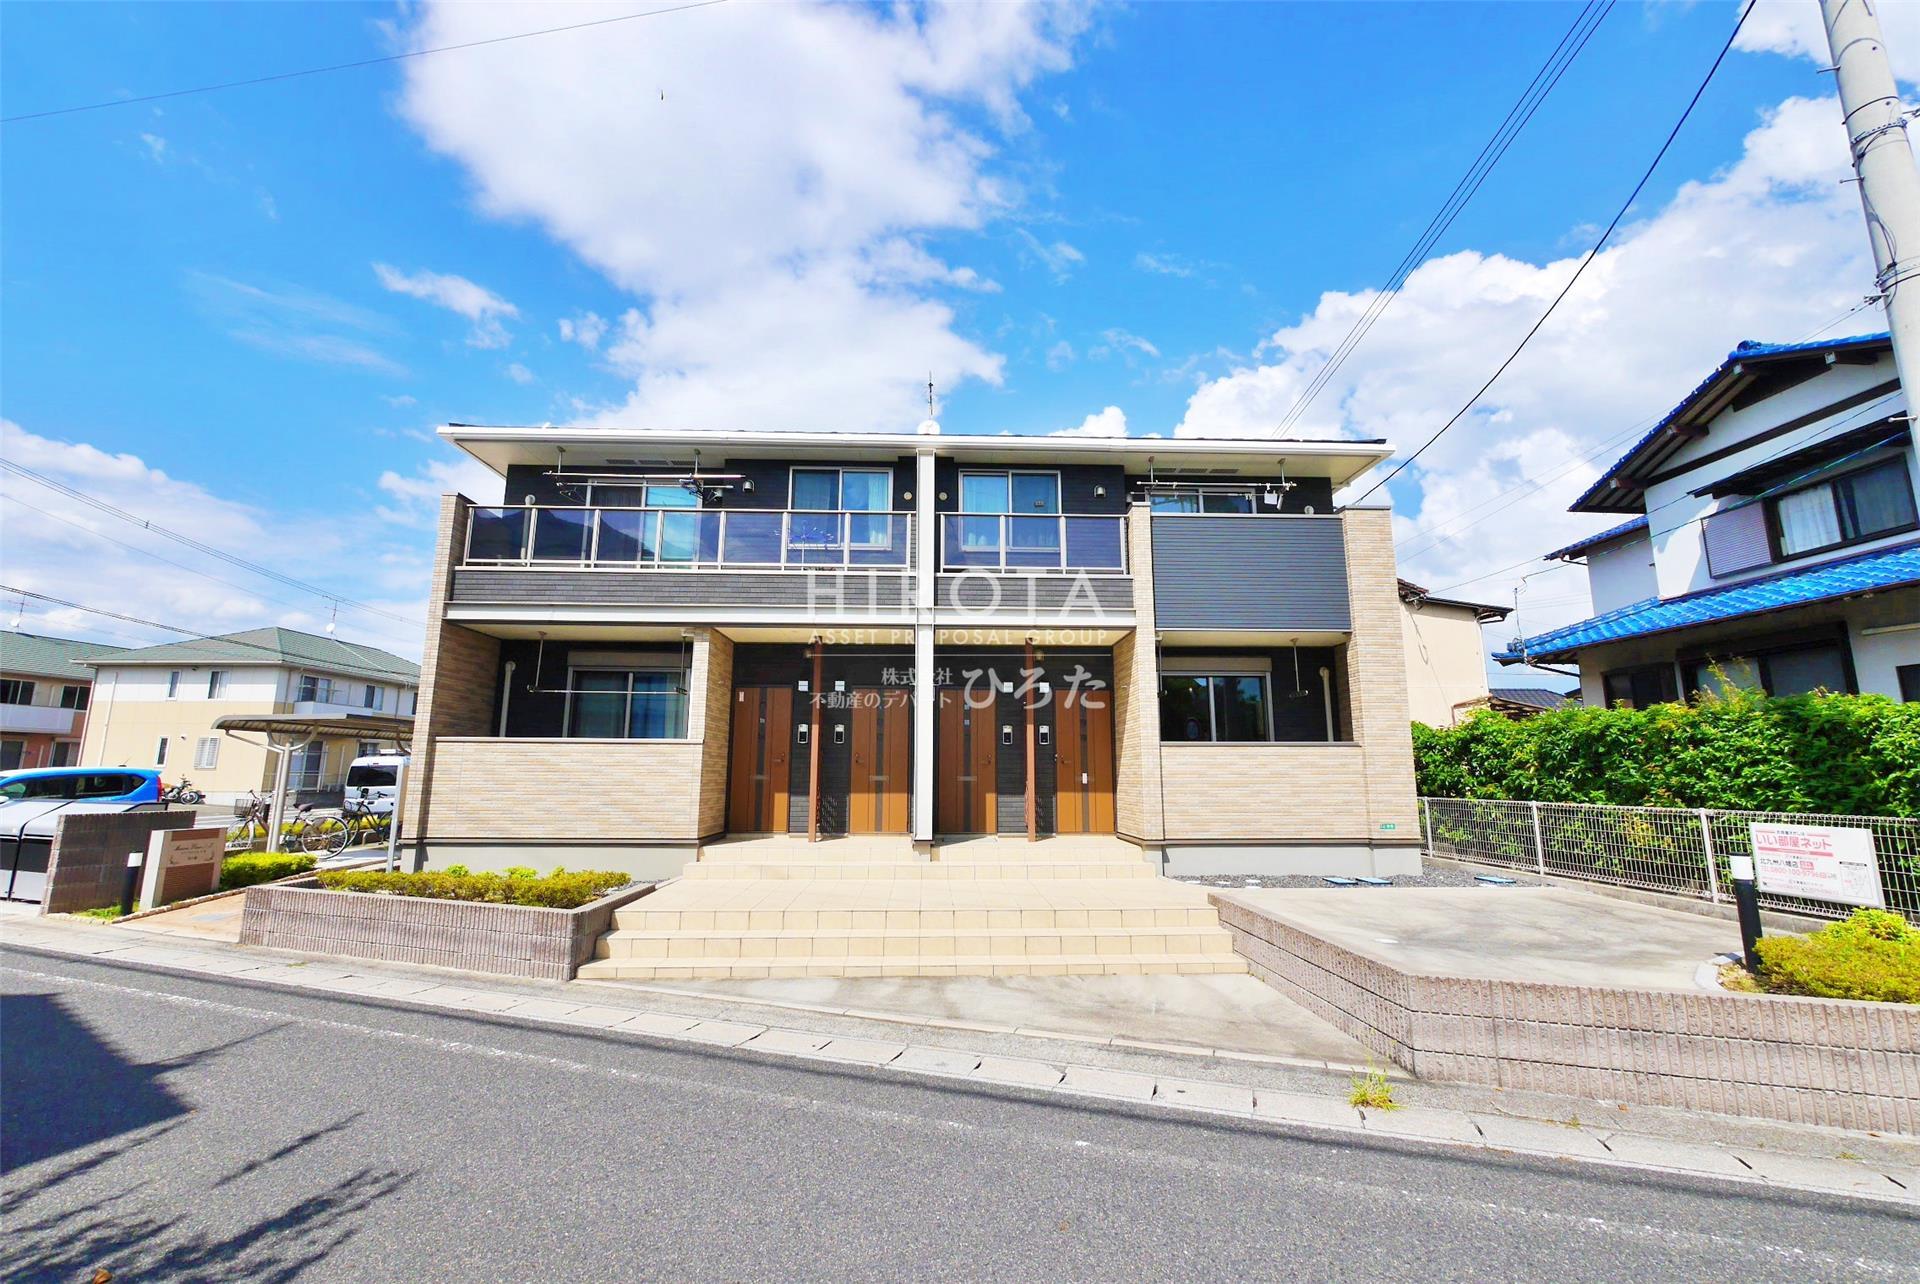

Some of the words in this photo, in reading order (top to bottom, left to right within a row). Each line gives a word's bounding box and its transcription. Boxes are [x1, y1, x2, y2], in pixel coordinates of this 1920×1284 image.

[1755, 834, 1832, 849] いい部屋ネット
